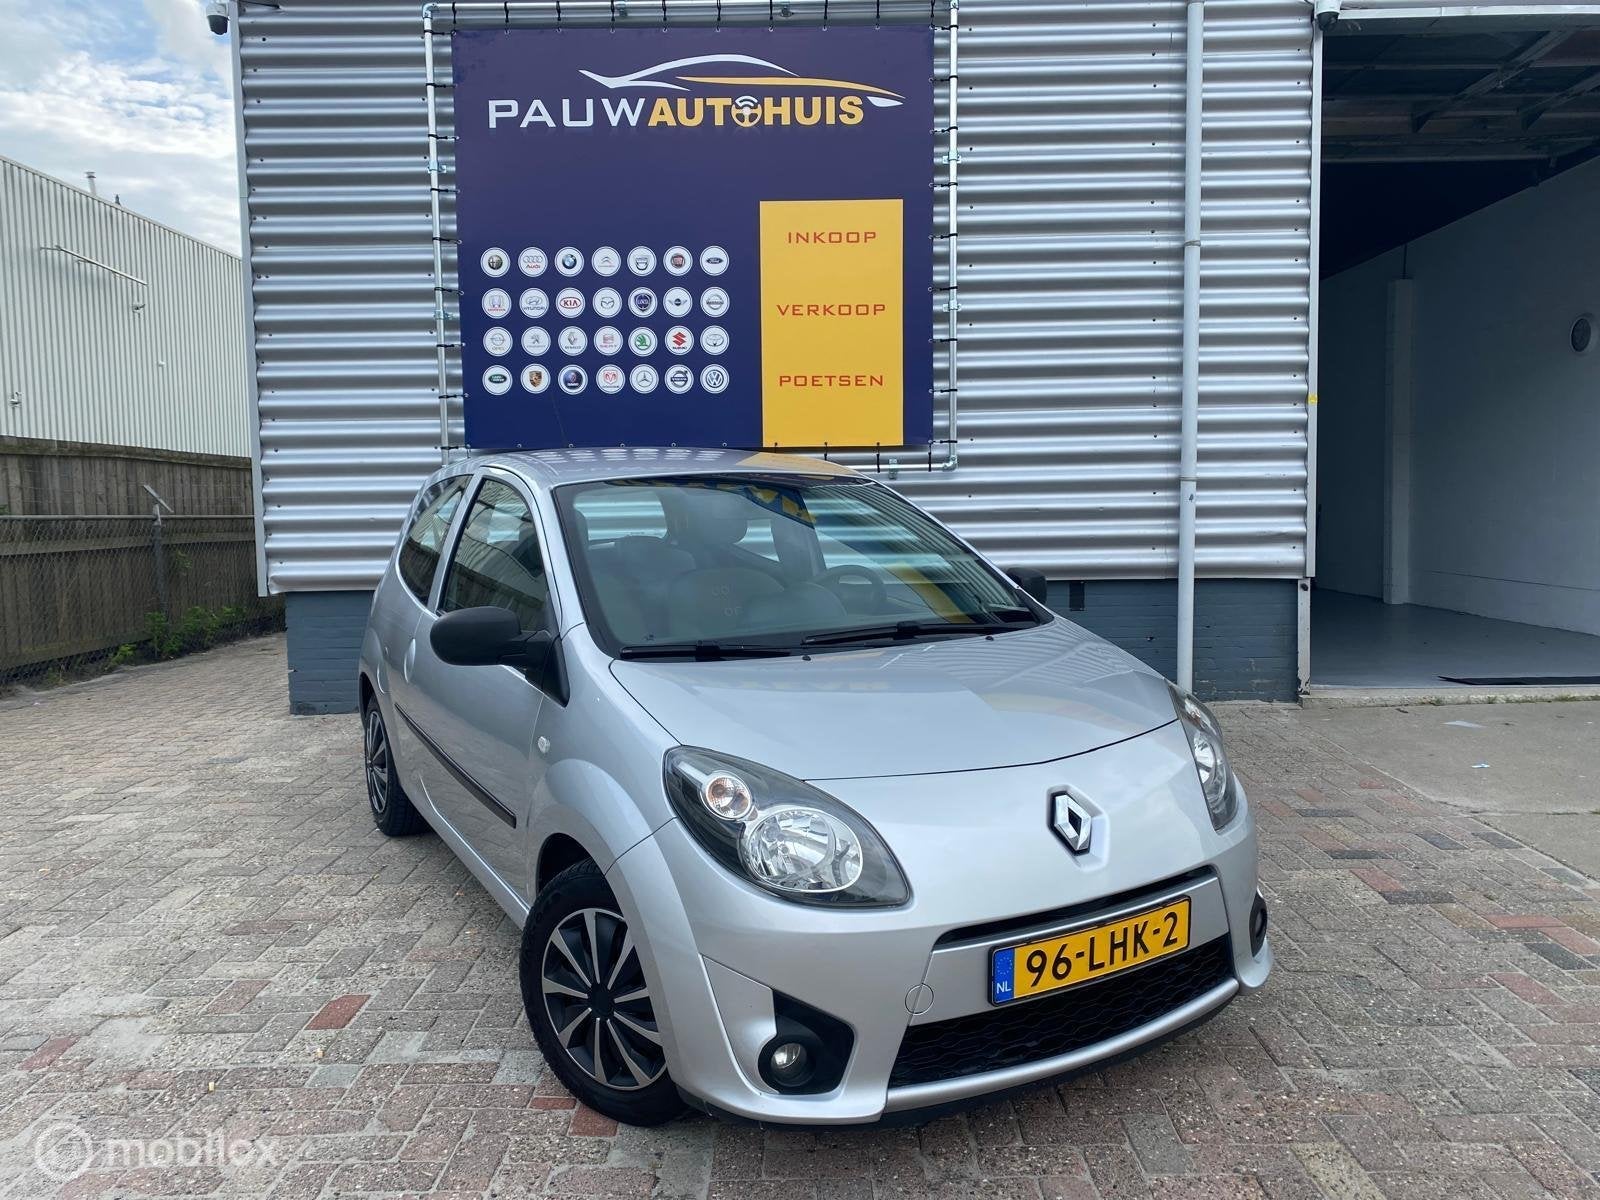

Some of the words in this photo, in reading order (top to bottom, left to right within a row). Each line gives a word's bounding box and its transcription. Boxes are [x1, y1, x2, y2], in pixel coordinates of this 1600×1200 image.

[788, 232, 876, 243] INKOOP
[776, 304, 886, 315] VERKOOP
[779, 375, 883, 386] POETSEN
[996, 981, 1012, 994] NL
[1026, 911, 1178, 987] 96-LHK-2
